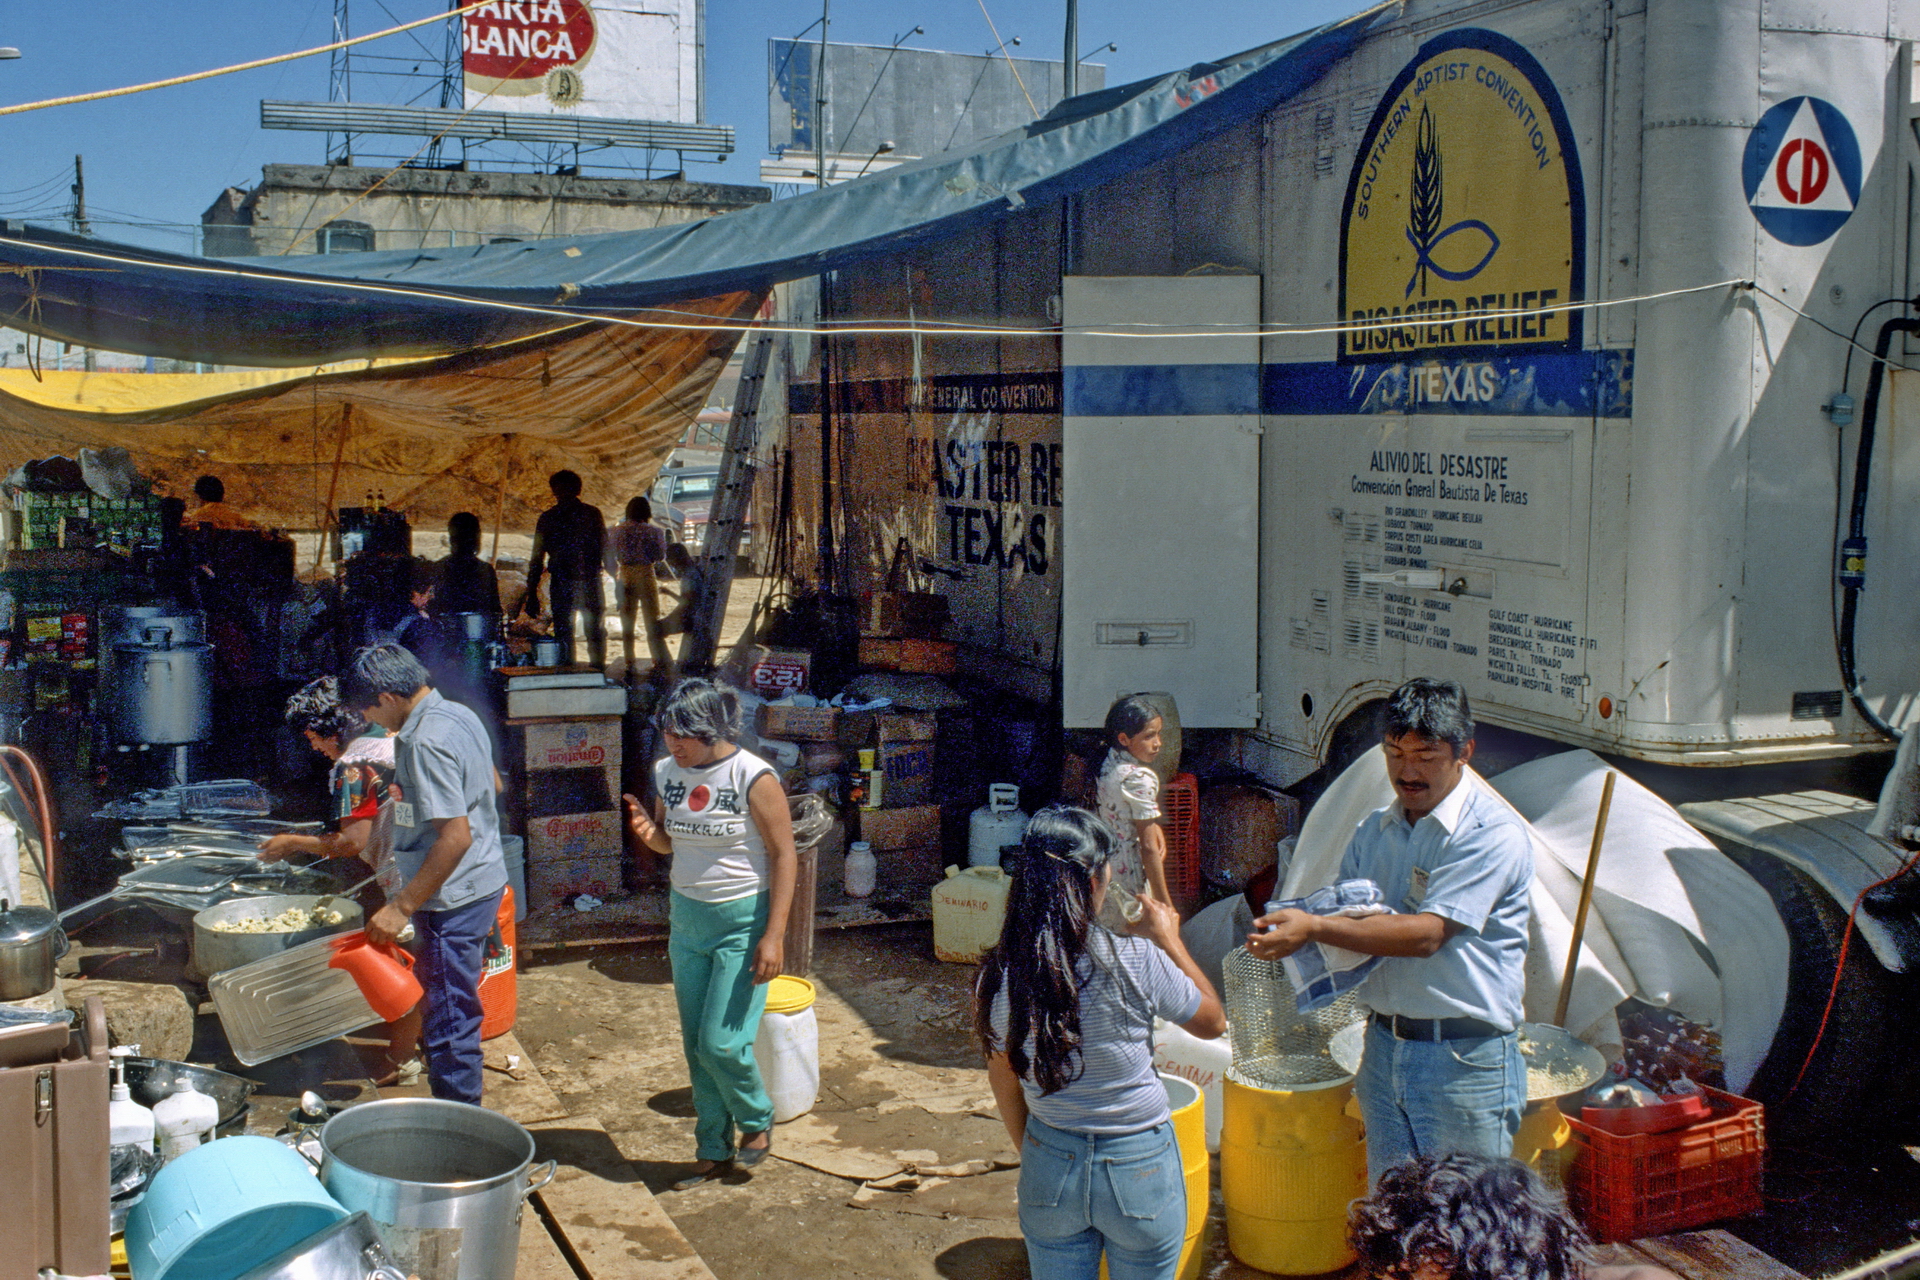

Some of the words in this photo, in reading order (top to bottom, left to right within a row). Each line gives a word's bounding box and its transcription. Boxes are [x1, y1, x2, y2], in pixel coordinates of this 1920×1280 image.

[462, 0, 566, 25] ARTA
[1358, 98, 1411, 220] SOUTHERN
[1414, 63, 1470, 97] APTIST
[1475, 65, 1551, 170] CONVENTION
[1776, 138, 1829, 204] CD
[1352, 298, 1458, 351] DISASTER
[1464, 289, 1558, 342] RELIEF
[981, 383, 1055, 409] CONVENTION
[1413, 365, 1495, 401] TEXAS
[1370, 450, 1410, 473] ALIVIO
[1412, 451, 1433, 475] DEL
[1440, 453, 1508, 480] DESASTRE
[1439, 479, 1480, 502] Bautista
[1484, 482, 1497, 503] De
[1499, 483, 1528, 506] Texas
[945, 504, 1048, 575] TEXAS
[1488, 609, 1506, 621] GULF
[1507, 611, 1529, 624] COAST
[1487, 658, 1515, 673] WICHITA
[1530, 653, 1562, 669] TORNADO
[1553, 645, 1575, 659] FLOOD
[1487, 670, 1519, 686] PARKLAND
[1521, 677, 1553, 693] HOSPITAL
[706, 786, 742, 815] 風
[664, 818, 736, 837] AMIKAZE
[933, 884, 989, 911] SEMINARIO
